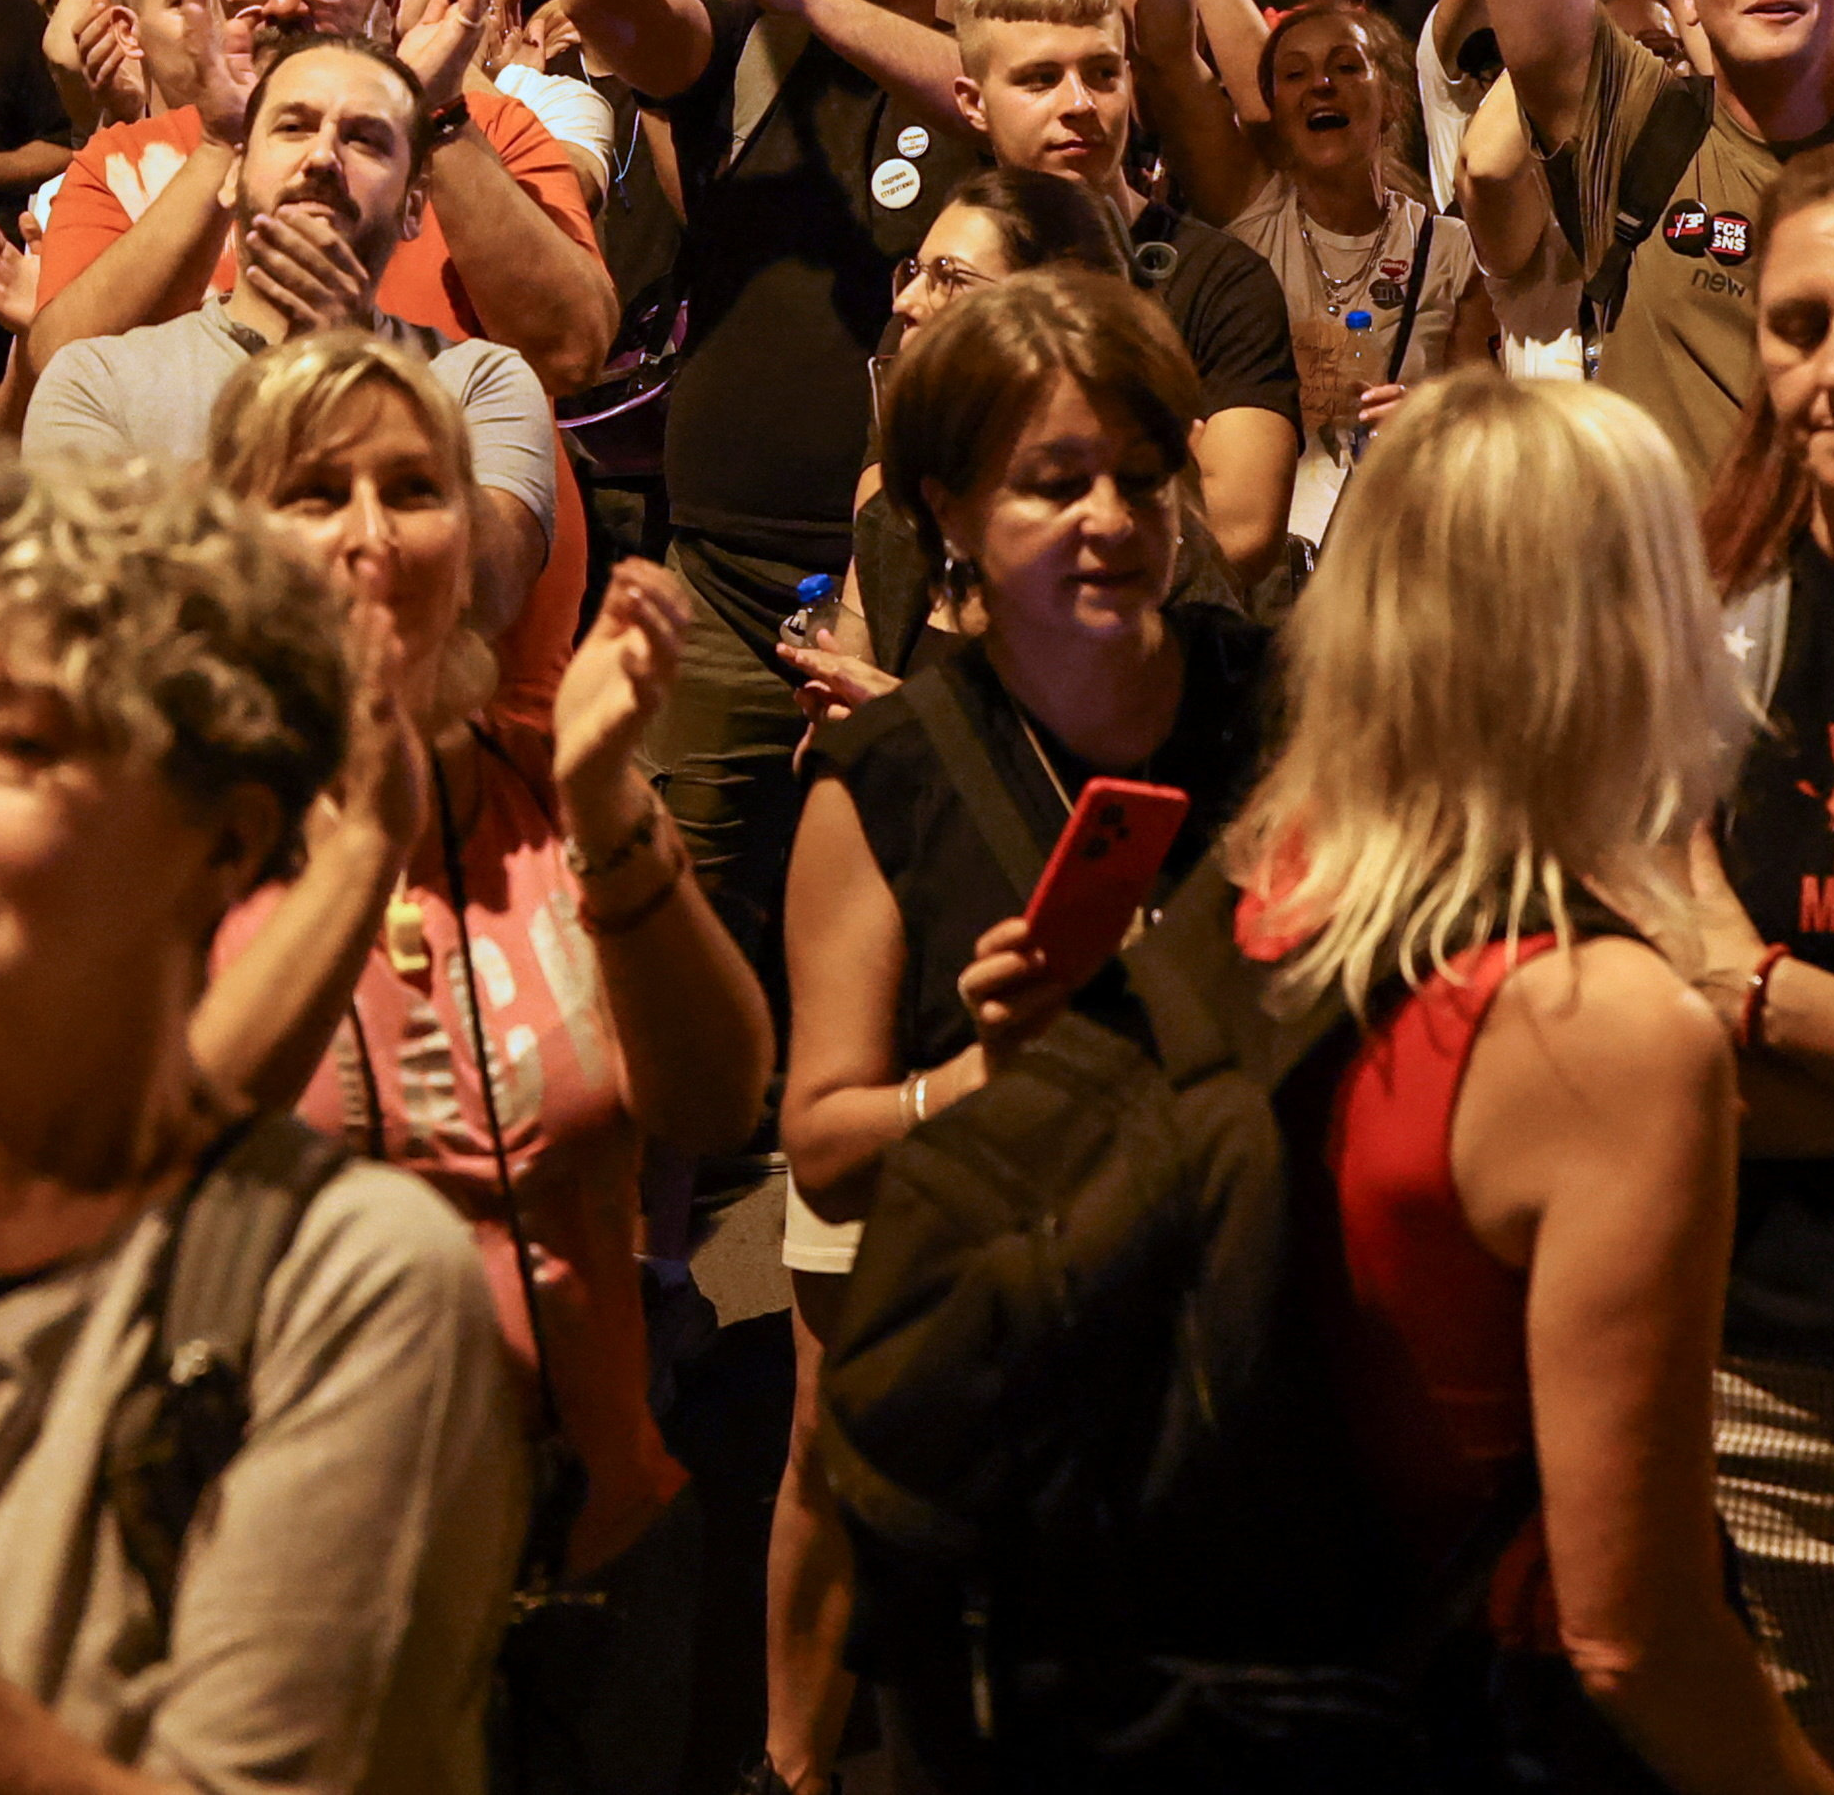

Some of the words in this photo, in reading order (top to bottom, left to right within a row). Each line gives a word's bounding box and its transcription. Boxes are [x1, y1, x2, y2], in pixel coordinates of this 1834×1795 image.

[1713, 220, 1747, 239] FCK
[1711, 233, 1747, 252] SNS
[1691, 268, 1746, 298] new
